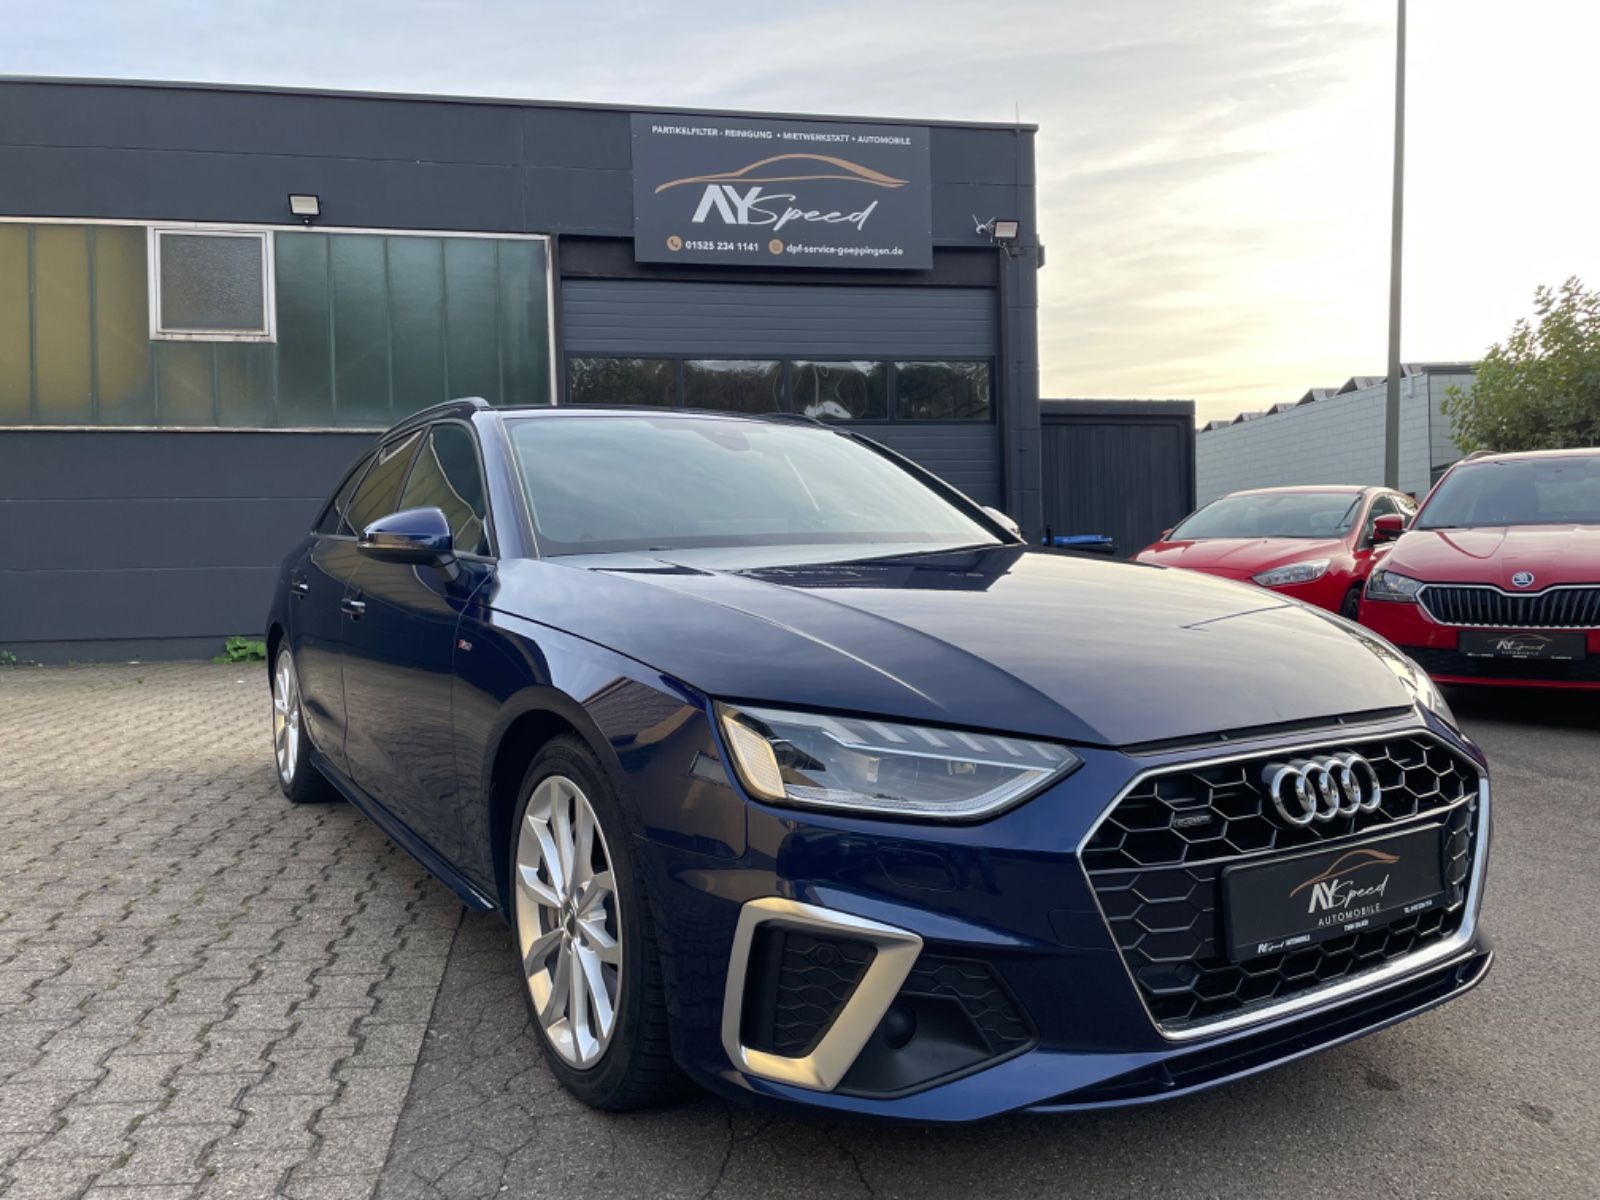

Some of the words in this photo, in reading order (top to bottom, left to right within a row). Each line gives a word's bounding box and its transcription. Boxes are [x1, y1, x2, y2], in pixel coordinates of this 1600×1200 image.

[651, 125, 718, 136] PARTIKELFILTER
[725, 129, 773, 139] REINIGUNG
[783, 131, 850, 142] MIETWERKSTATT
[857, 135, 911, 145] AUTOMOBILE
[685, 240, 715, 250] 01525
[717, 241, 734, 251] 234
[736, 242, 759, 252] 1141
[786, 243, 904, 257] dpf-service-goeppingen.de
[1318, 902, 1381, 926] AUTOMOBILE
